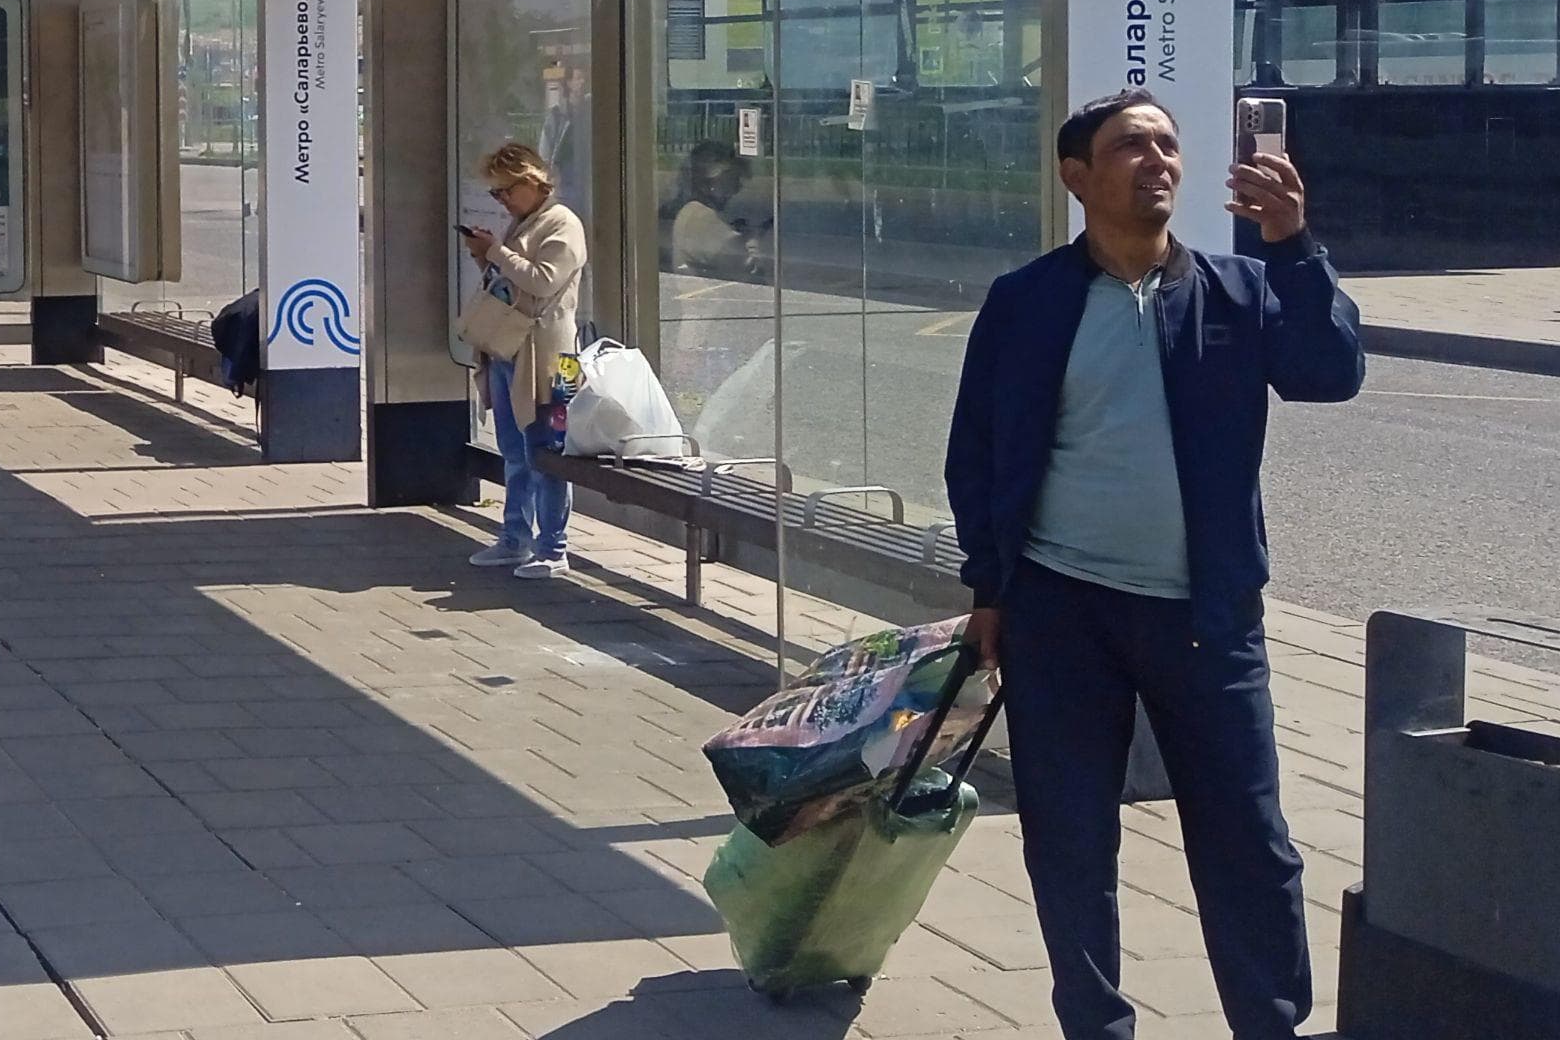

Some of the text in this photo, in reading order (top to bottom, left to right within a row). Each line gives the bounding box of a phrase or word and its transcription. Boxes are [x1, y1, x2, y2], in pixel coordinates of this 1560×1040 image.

[315, 52, 325, 90] Metro
[1158, 11, 1176, 82] Metro
[295, 119, 313, 184] Метро
